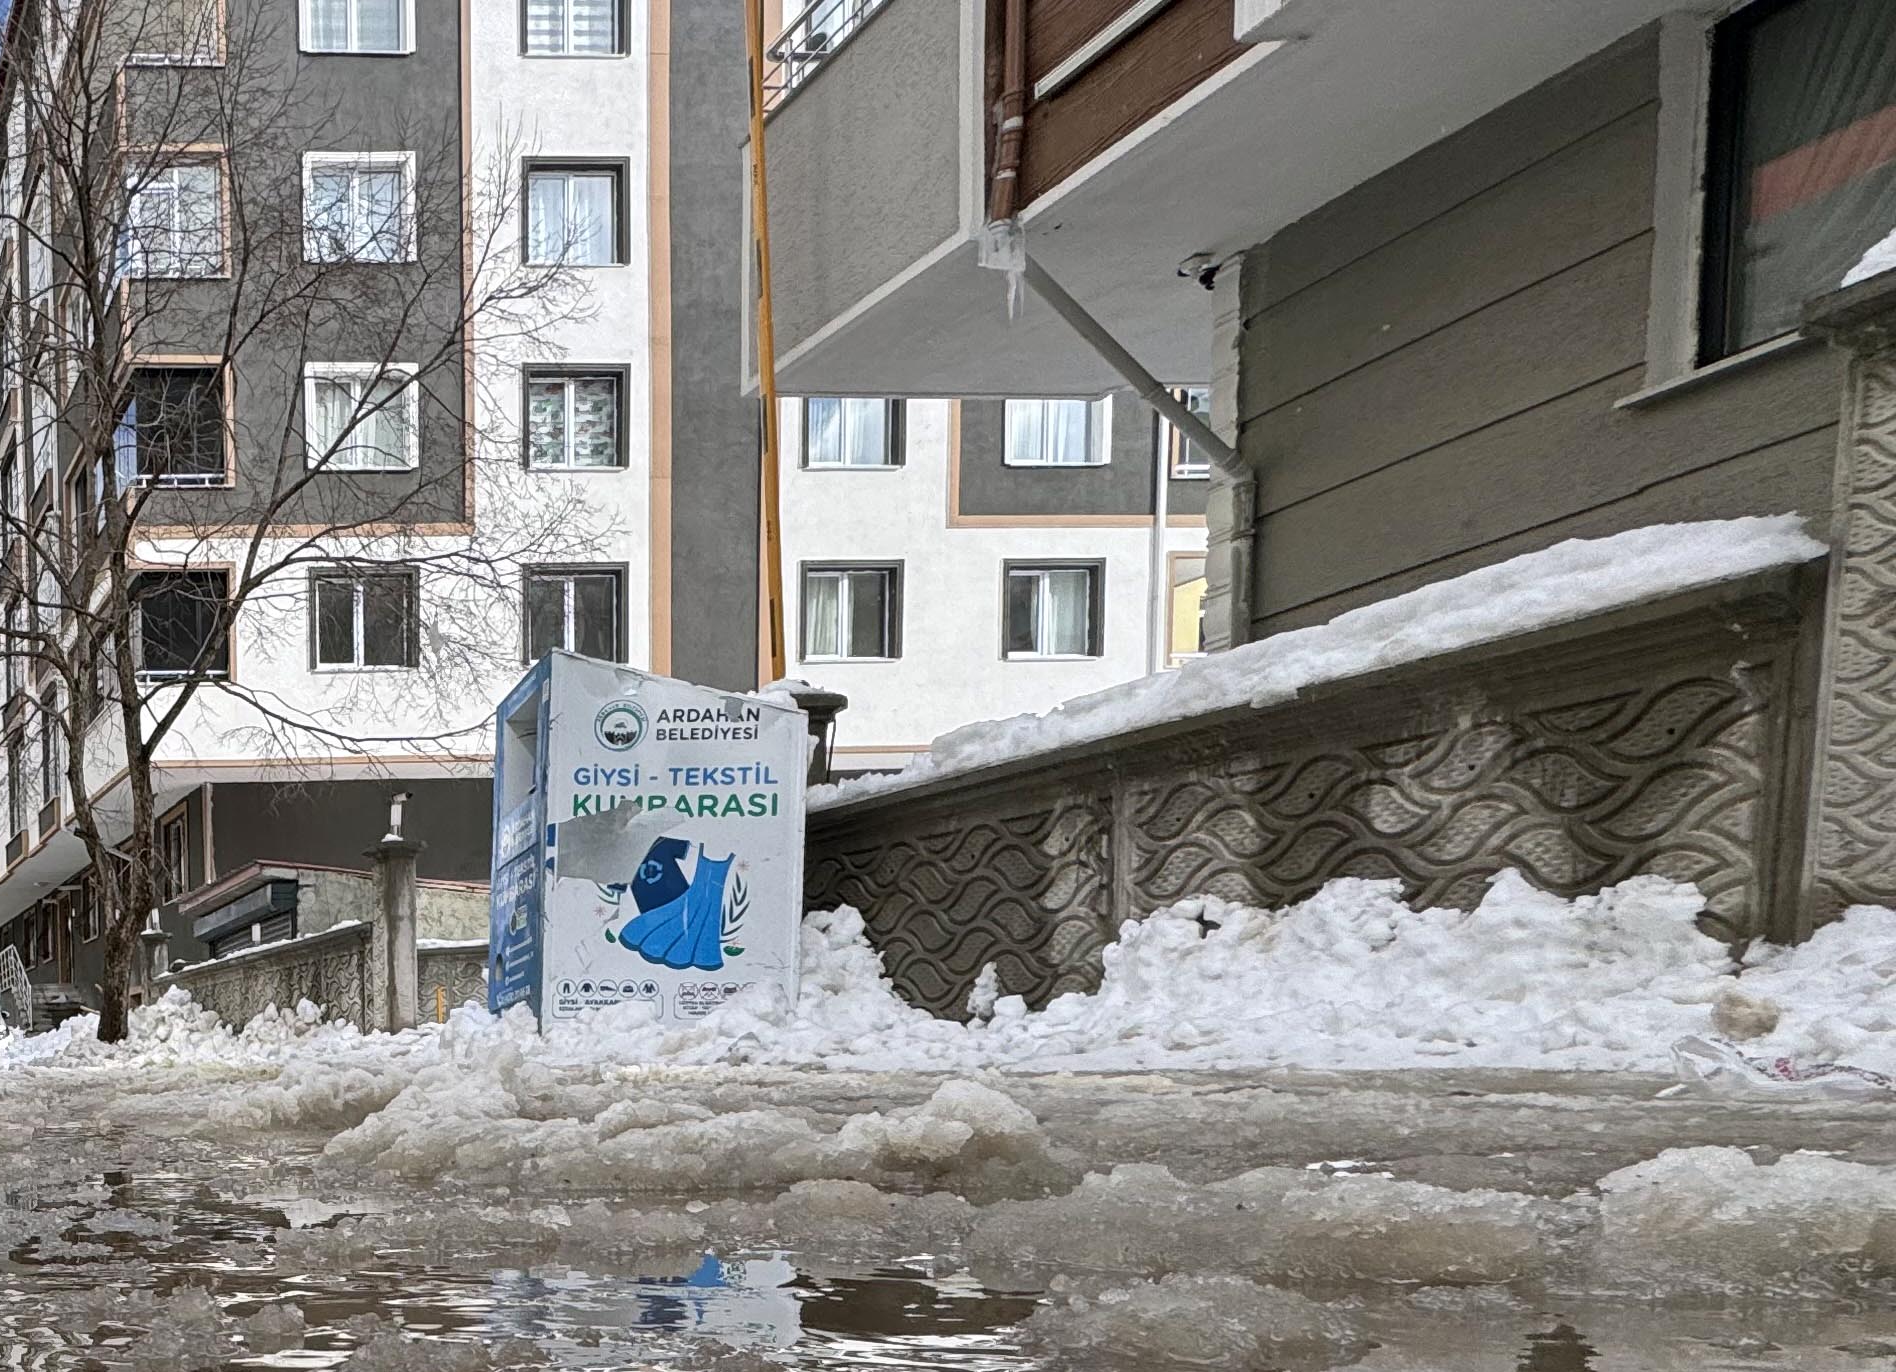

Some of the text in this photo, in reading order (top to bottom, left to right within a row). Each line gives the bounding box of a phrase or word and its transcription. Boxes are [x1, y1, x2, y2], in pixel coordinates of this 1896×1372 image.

[656, 725, 759, 741] BELEDİYESİ
[573, 763, 640, 787] GİYSİ
[668, 761, 779, 786] TEKSTİL
[572, 792, 779, 818] KUBARASI
